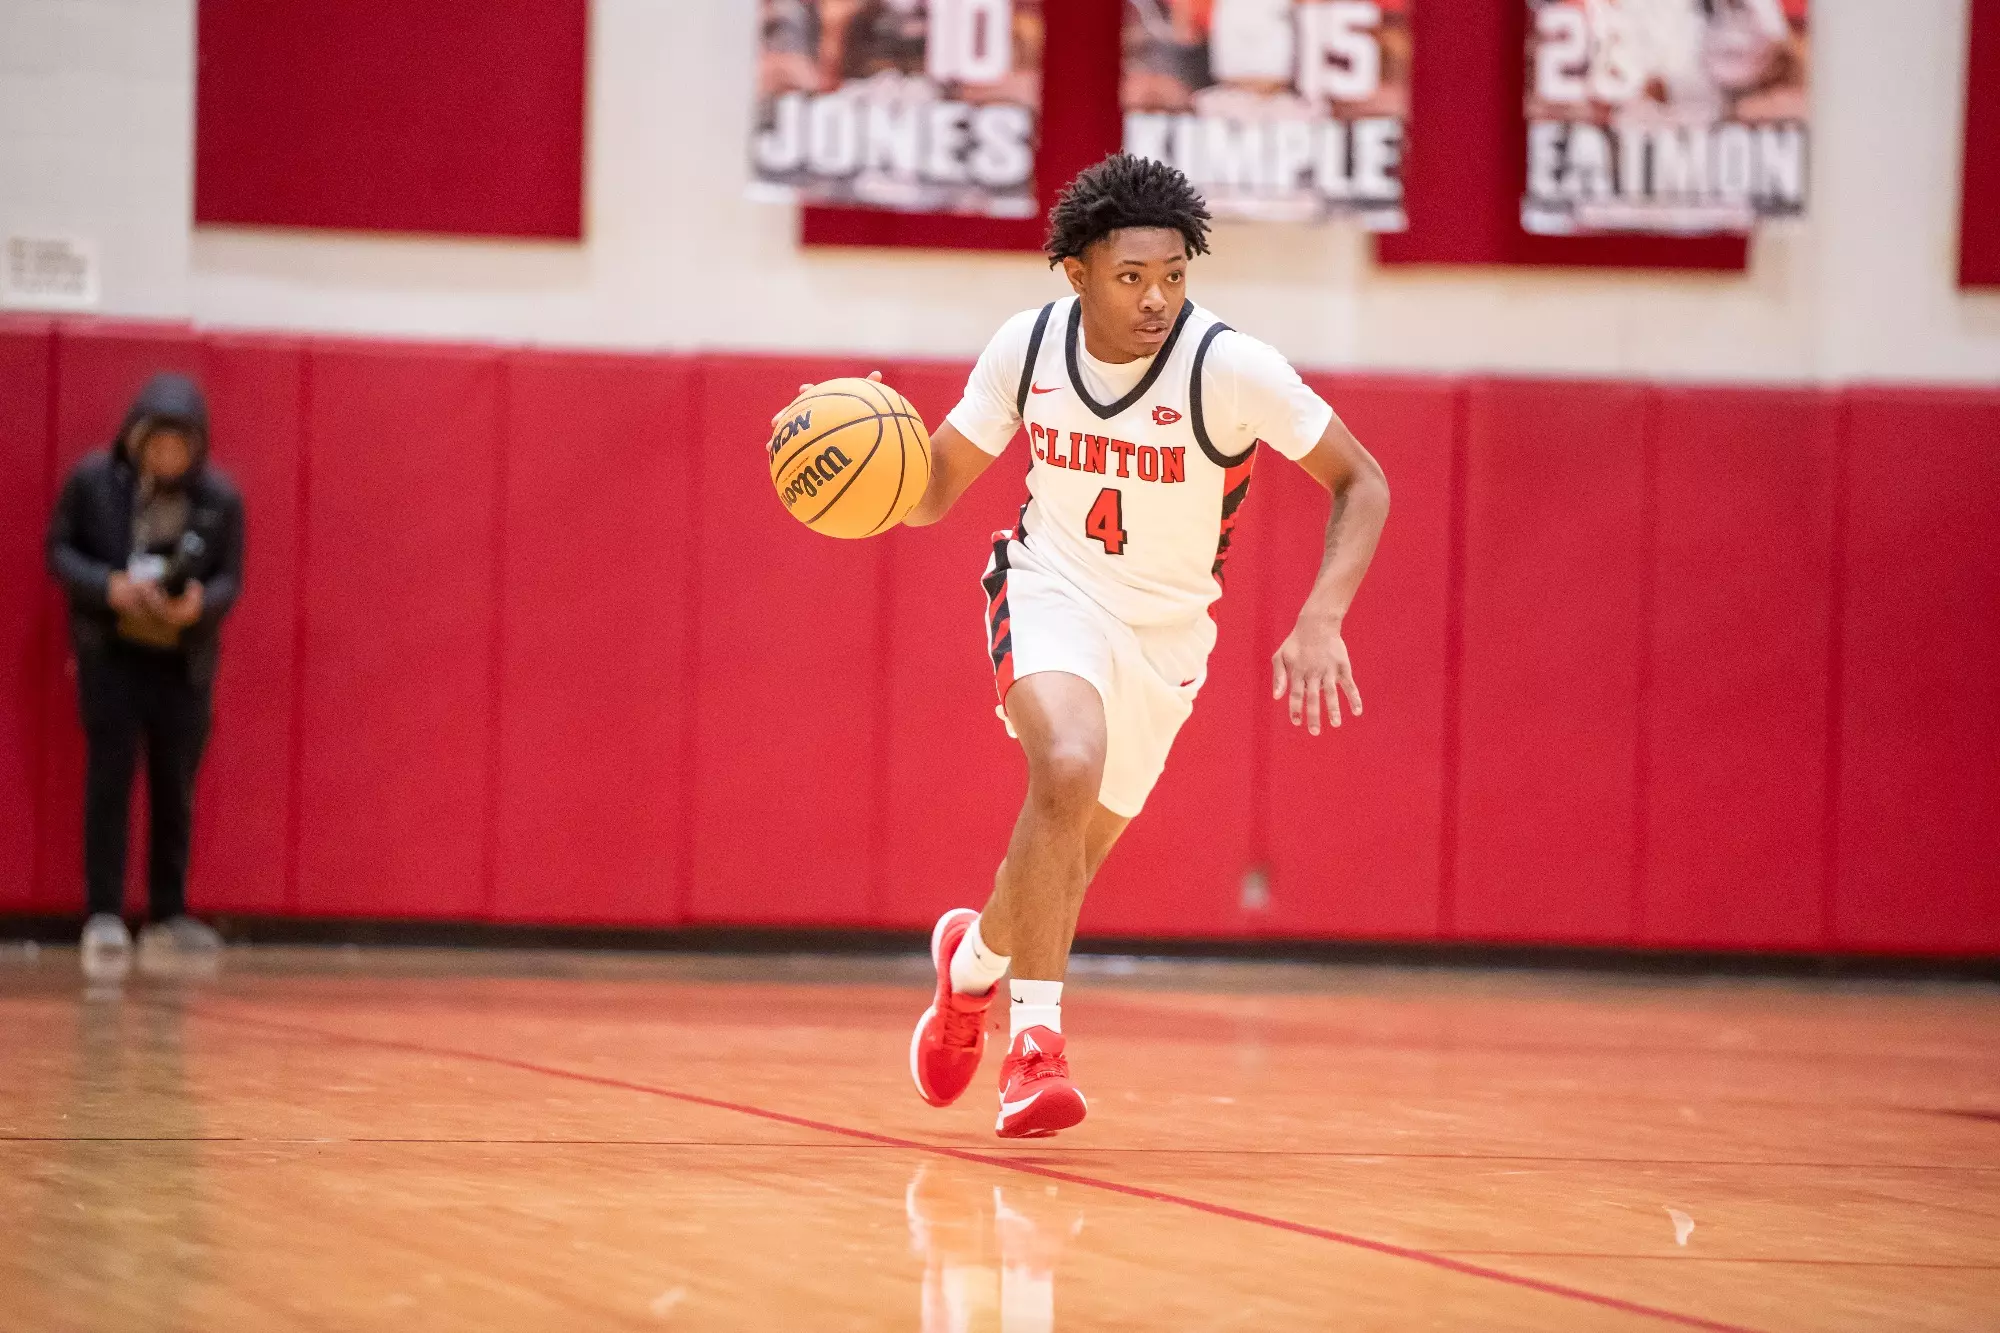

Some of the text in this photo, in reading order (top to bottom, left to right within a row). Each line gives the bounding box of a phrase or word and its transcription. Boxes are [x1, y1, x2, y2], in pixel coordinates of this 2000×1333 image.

[926, 0, 1012, 82] 10
[1300, 2, 1382, 101] 15
[756, 96, 1032, 184] JONES
[1530, 119, 1802, 199] EATMON
[1030, 421, 1186, 484] CLINTON
[1085, 487, 1128, 556] 4
